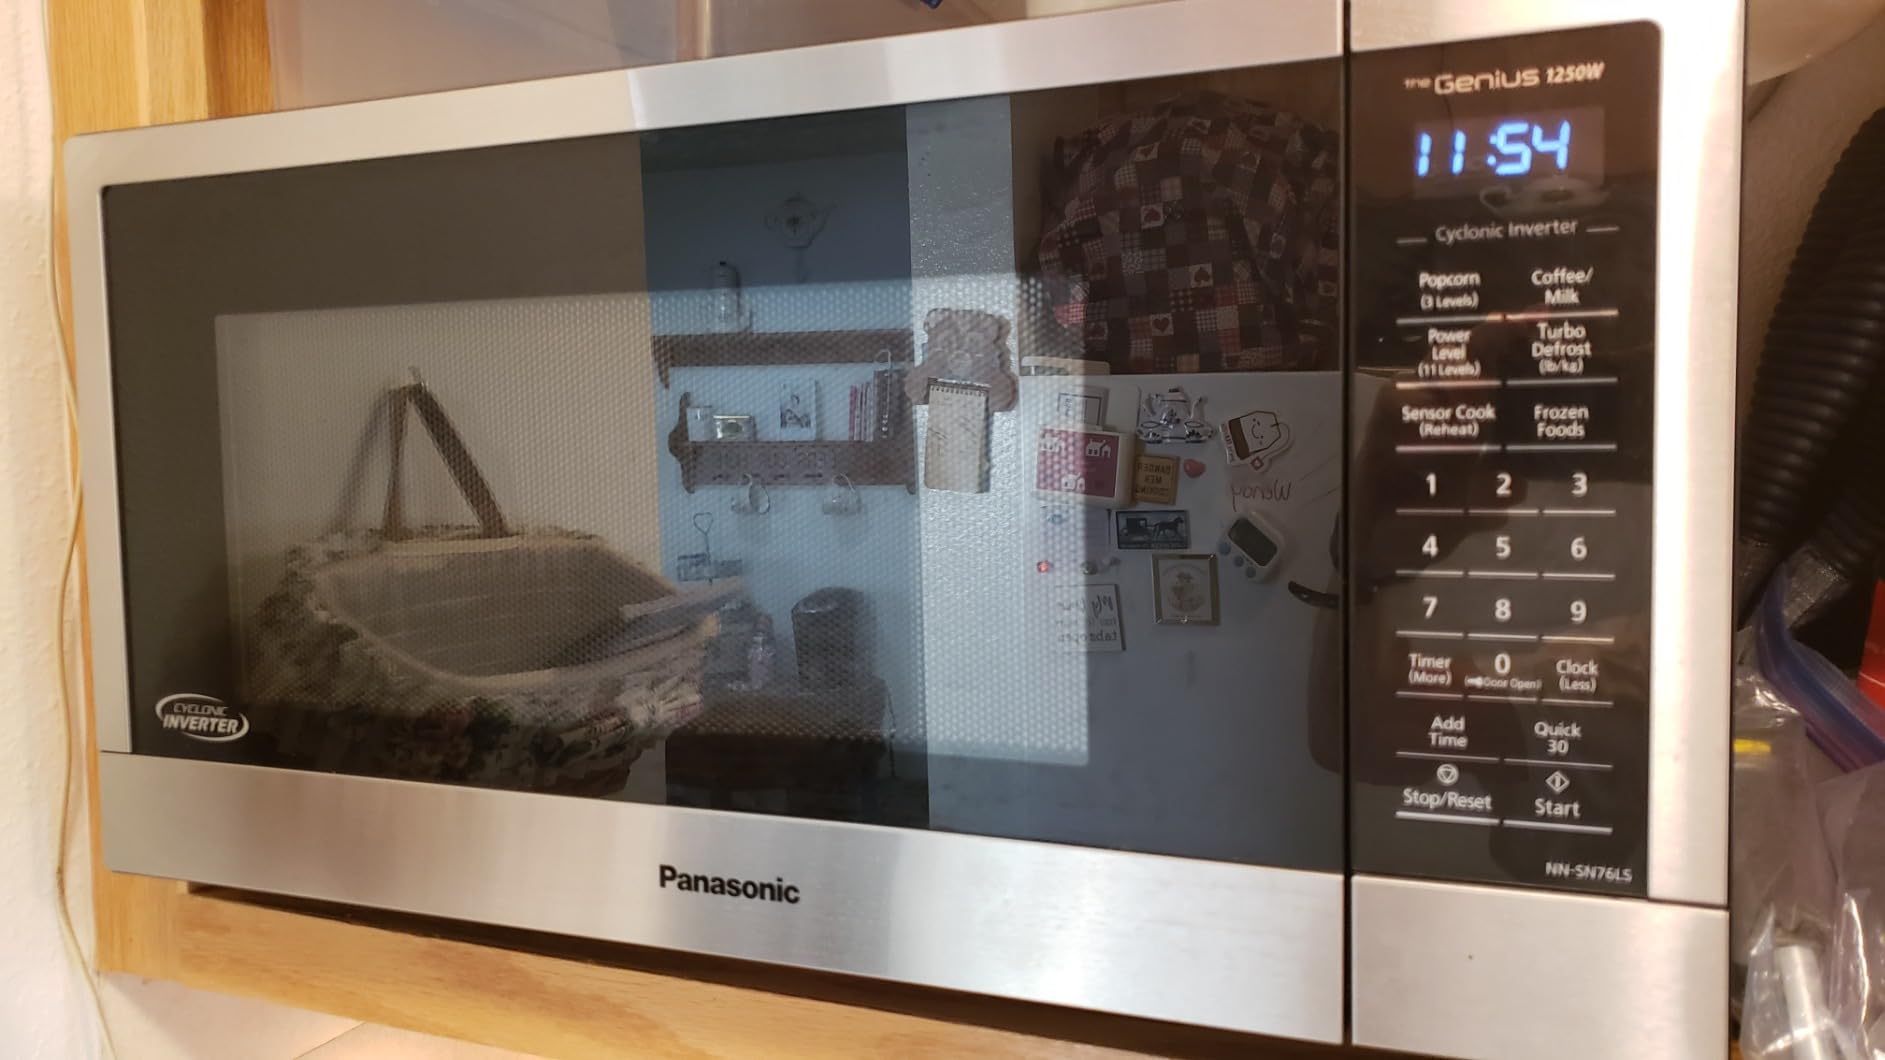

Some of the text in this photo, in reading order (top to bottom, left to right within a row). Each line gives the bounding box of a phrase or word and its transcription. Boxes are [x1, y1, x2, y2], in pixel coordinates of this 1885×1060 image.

[1434, 68, 1540, 95] Genius
[1546, 62, 1605, 84] 1250W
[1416, 119, 1571, 176] 11:54
[1435, 219, 1578, 245] Cyclonic Inverter
[1419, 272, 1481, 289] Popcorn
[1531, 267, 1593, 285] Coffee/
[1420, 291, 1479, 310] (3 Levels)
[1545, 289, 1579, 304] Milk
[1428, 328, 1471, 345] Power
[1537, 321, 1586, 340] Turbo
[1432, 345, 1467, 361] Level
[1531, 341, 1591, 358] Defrost
[1417, 360, 1481, 377] (11 Levels)
[1401, 403, 1496, 421] Sensor Cook
[1534, 404, 1588, 420] Frozen
[1419, 420, 1479, 437] (Reheat)
[1537, 420, 1585, 437] Foods
[1425, 472, 1437, 496] 1
[1496, 473, 1512, 495] 2
[1571, 472, 1588, 496] 3
[1421, 534, 1439, 557] 4
[1495, 536, 1511, 558] 5
[1570, 537, 1588, 560] 6
[1422, 596, 1438, 619] 7
[1495, 598, 1511, 621] 8
[1570, 600, 1587, 623] 9
[1409, 653, 1451, 669] Timer
[1494, 653, 1511, 675] 0
[1556, 659, 1598, 676] Clock
[1408, 670, 1452, 685] (More)
[1510, 678, 1542, 690] Open)
[1559, 675, 1597, 693] (Less)
[162, 714, 239, 733] INVERTER
[1431, 716, 1466, 732] Add
[1534, 721, 1581, 738] Quick
[1429, 732, 1468, 748] Time
[1547, 739, 1569, 755] 30
[1403, 788, 1492, 810] Stop/Reset
[1534, 799, 1580, 818] Start
[1545, 862, 1633, 882] NN-SN76LS
[659, 864, 801, 904] Panasonic
